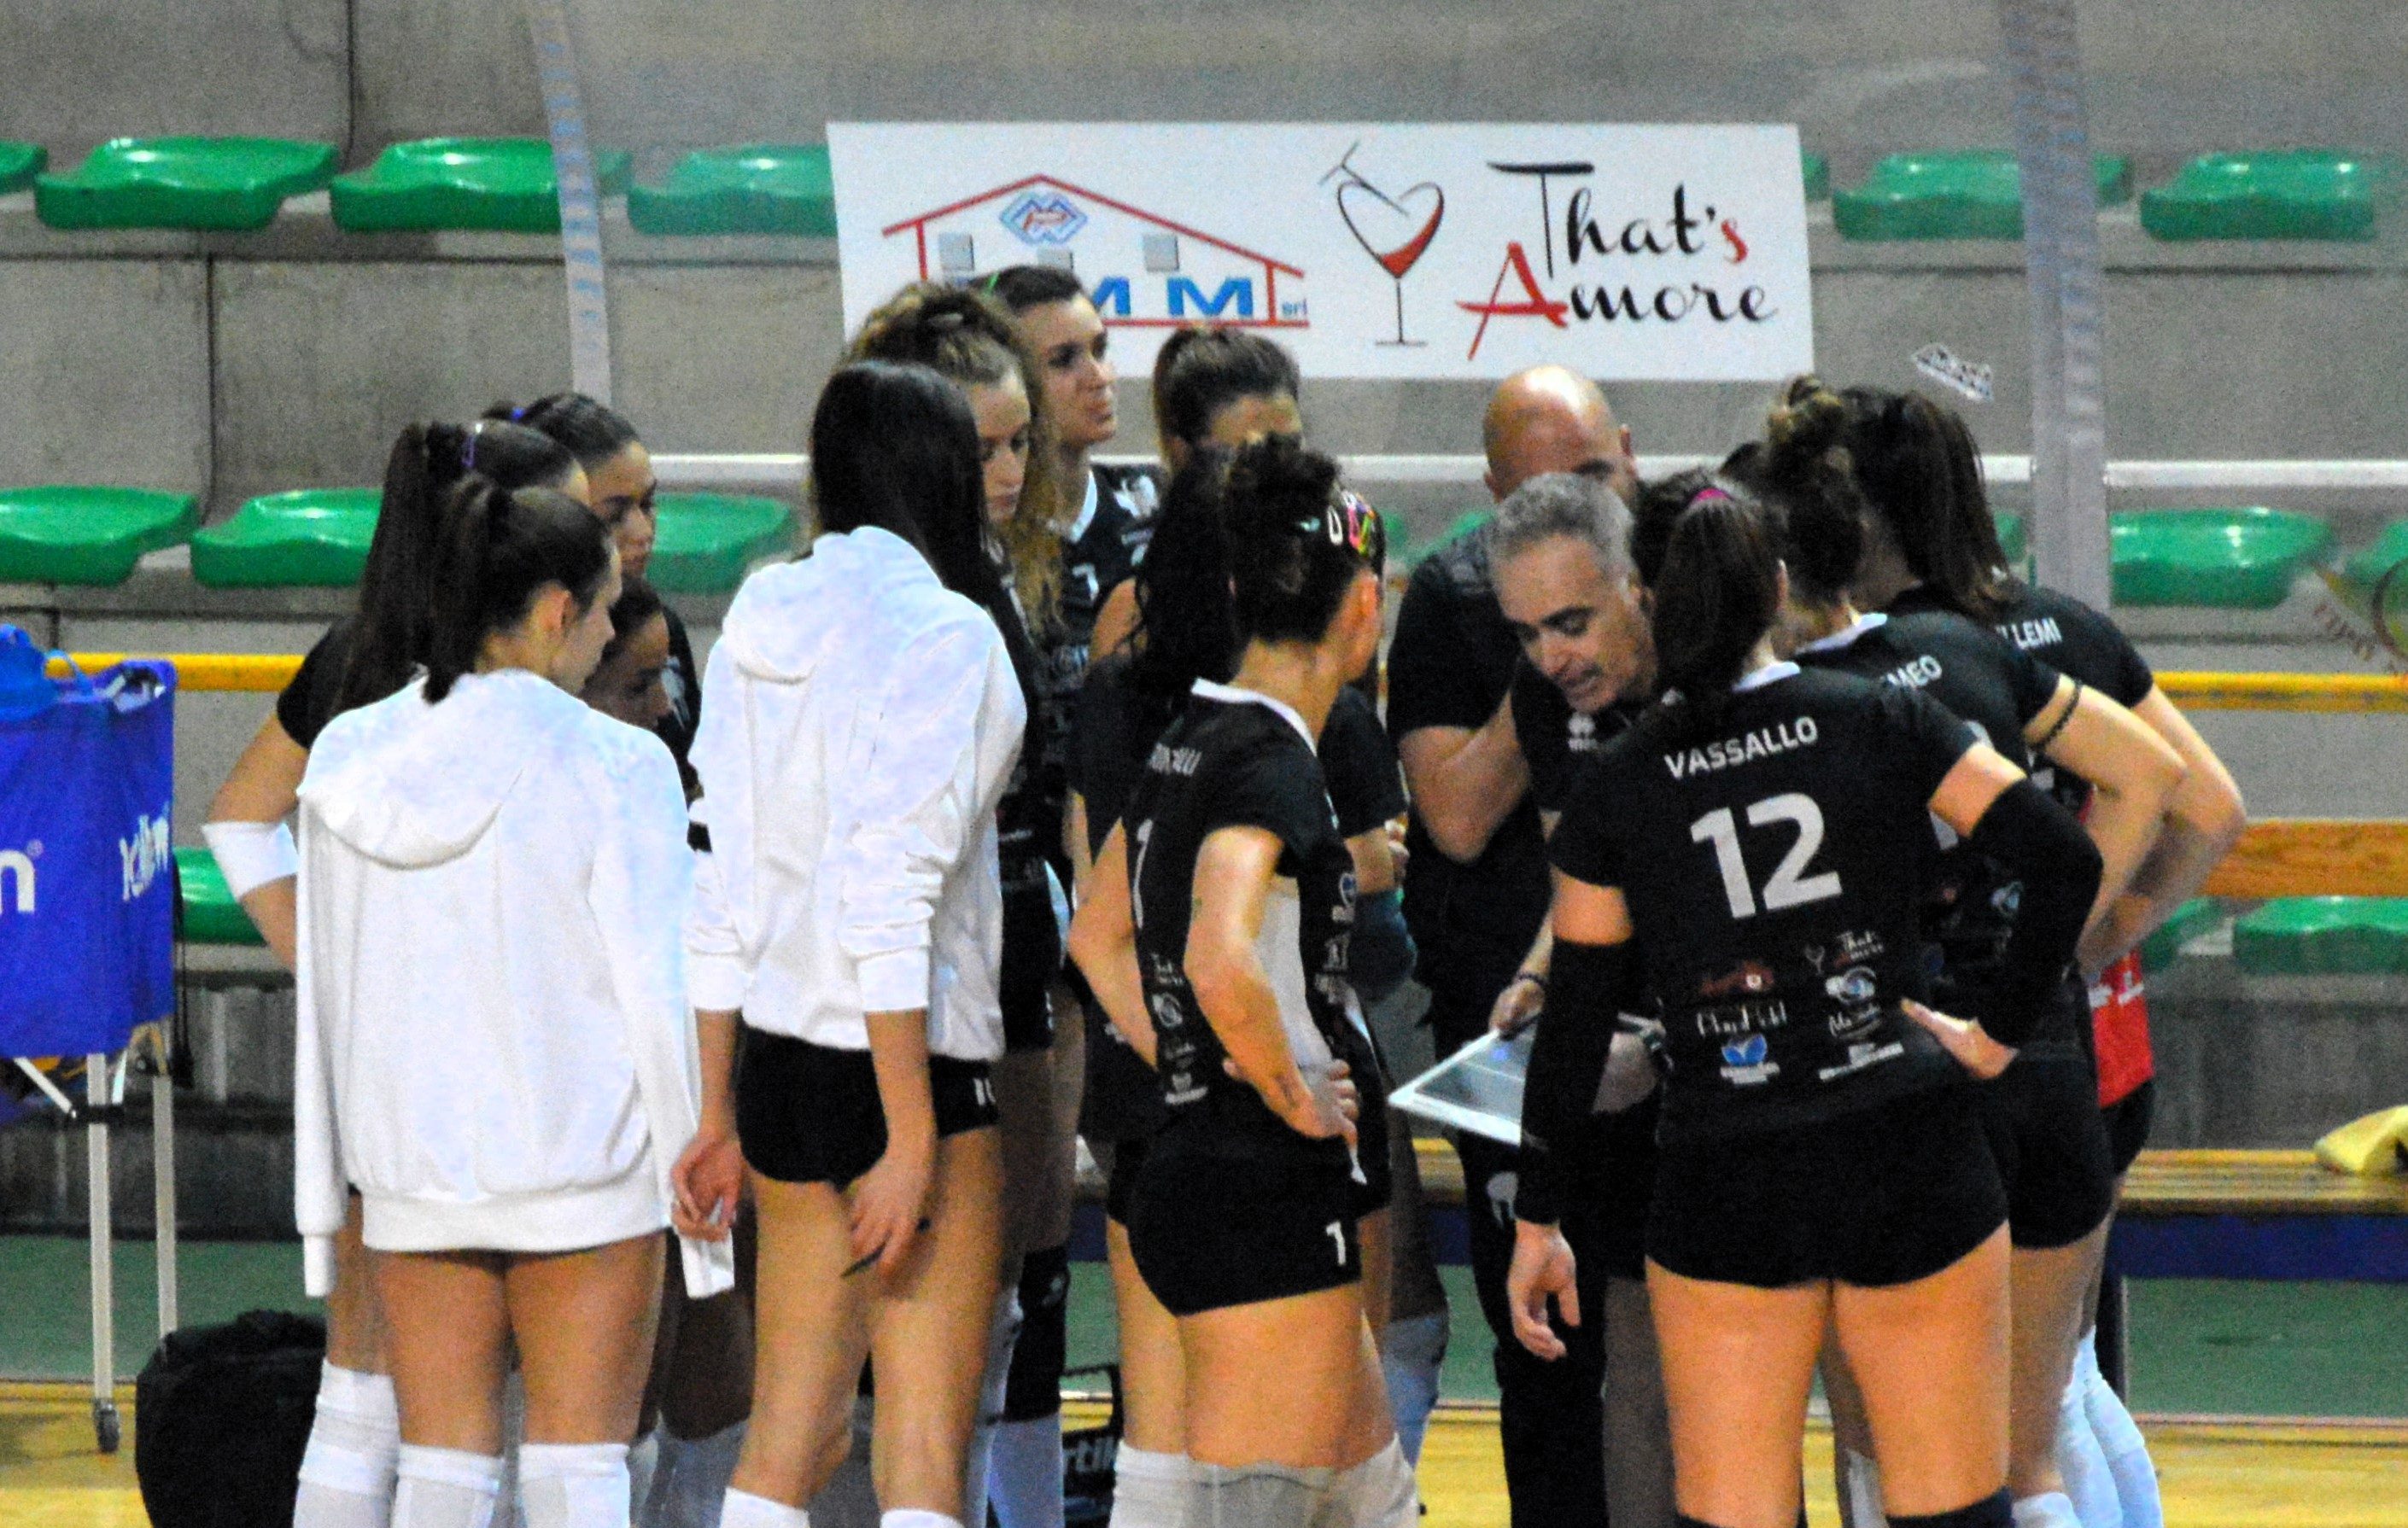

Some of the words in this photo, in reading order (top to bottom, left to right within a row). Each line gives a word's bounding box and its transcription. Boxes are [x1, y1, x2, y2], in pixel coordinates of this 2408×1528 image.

[1486, 160, 1749, 279] That's
[1456, 241, 1780, 361] Amore
[1664, 715, 1819, 780] VASSALLO
[1690, 792, 1843, 919] 12
[1325, 1221, 1347, 1265] 1
